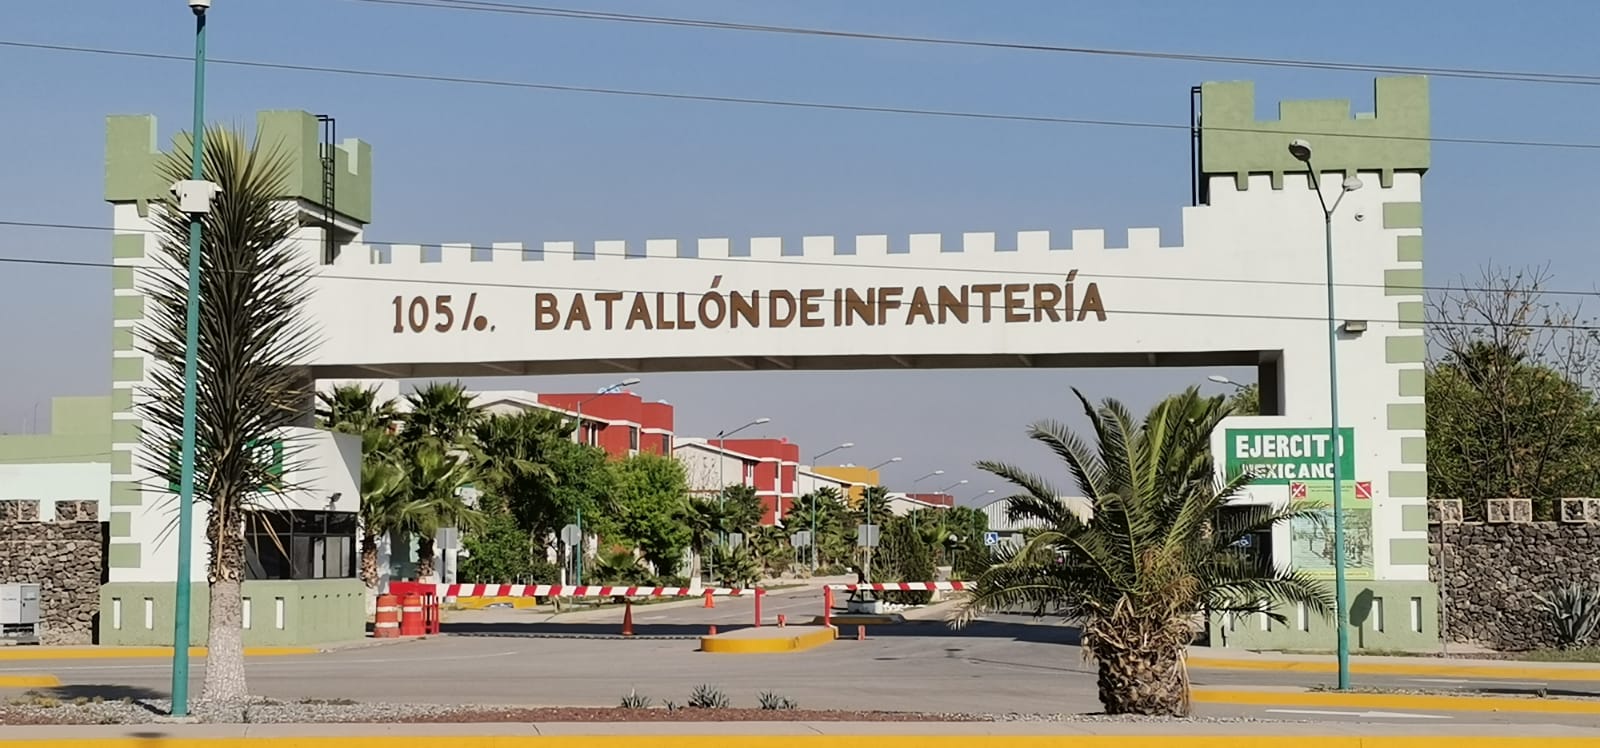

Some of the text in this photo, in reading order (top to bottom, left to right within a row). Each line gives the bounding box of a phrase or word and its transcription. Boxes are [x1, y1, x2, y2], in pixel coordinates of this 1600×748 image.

[535, 275, 761, 331] BATALLÓN
[769, 288, 825, 328] DE
[834, 269, 1107, 327] INFANTERÍA
